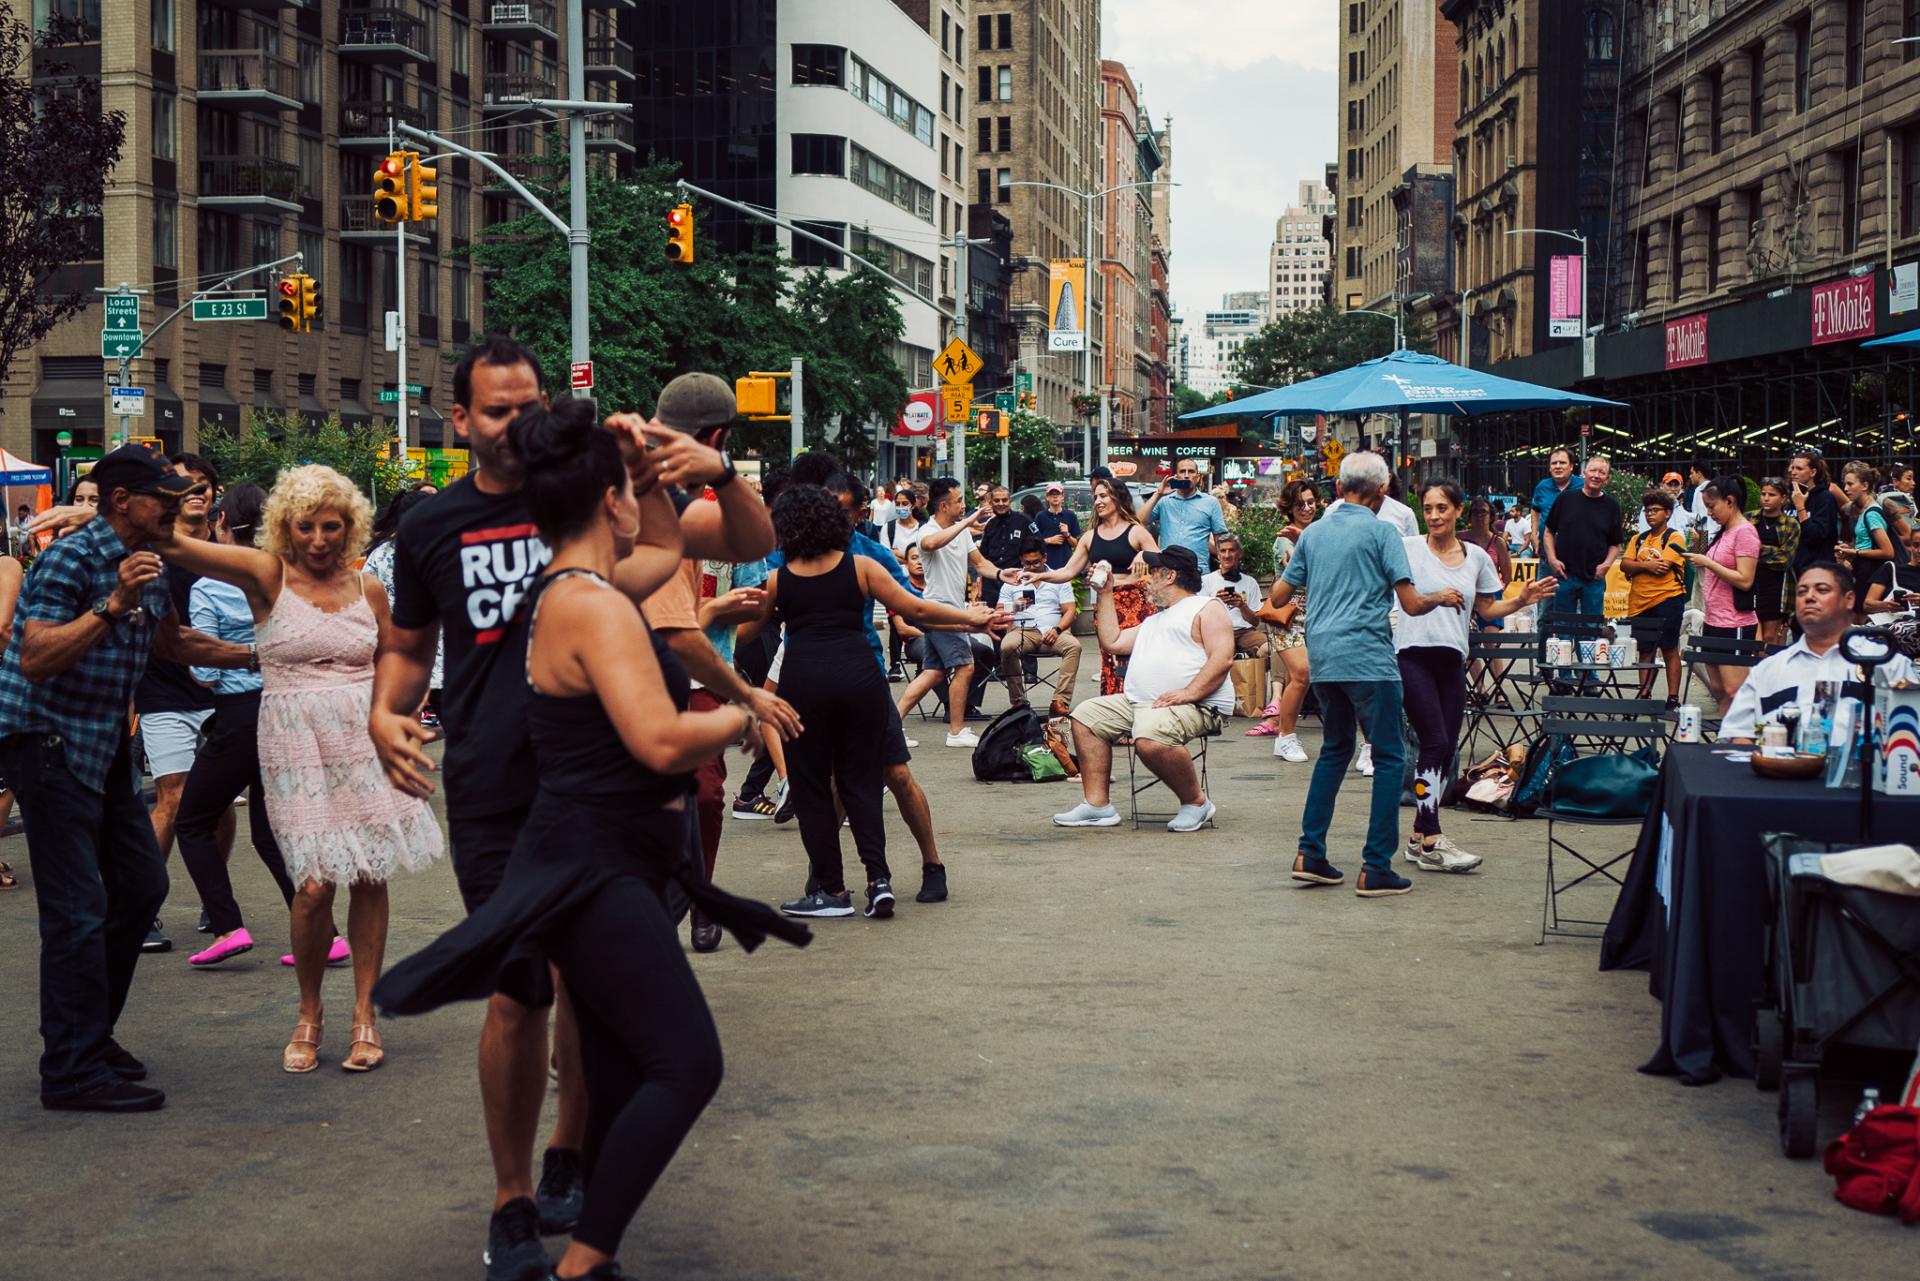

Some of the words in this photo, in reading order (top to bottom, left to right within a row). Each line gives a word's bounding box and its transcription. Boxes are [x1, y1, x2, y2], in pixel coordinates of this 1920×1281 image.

[109, 298, 134, 306] Local
[107, 307, 137, 315] Streets
[211, 304, 217, 316] E
[221, 303, 233, 315] 23
[236, 303, 247, 315] St
[103, 333, 141, 341] Downtown
[1053, 336, 1078, 347] Cure
[954, 400, 963, 412] 5
[1107, 446, 1133, 455] BEER
[1141, 446, 1168, 455] WINE
[1175, 446, 1217, 456] COFFEE
[1897, 754, 1908, 791] Sound
